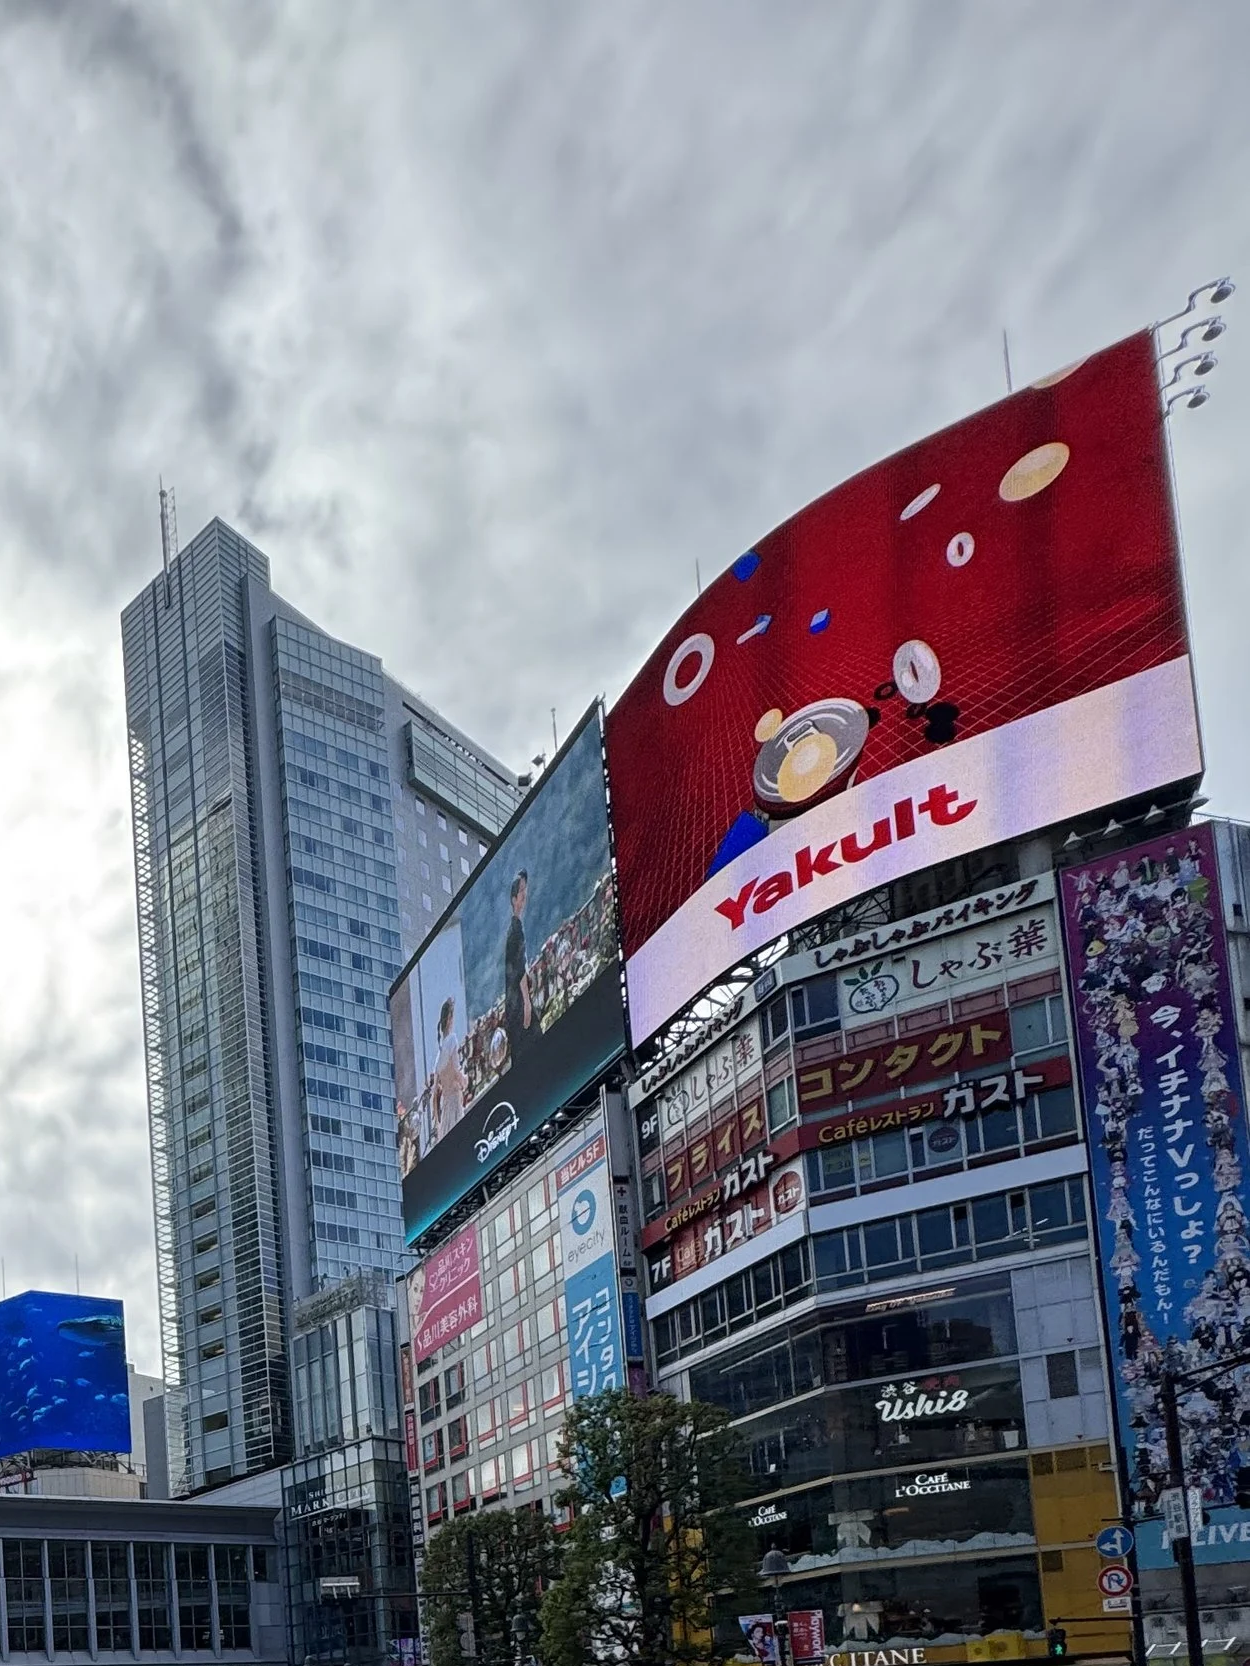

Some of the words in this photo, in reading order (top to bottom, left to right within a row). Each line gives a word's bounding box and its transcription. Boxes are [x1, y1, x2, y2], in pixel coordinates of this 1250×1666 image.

[714, 784, 978, 930] Yakult
[815, 880, 1039, 968] しゃぶしゃぶバイキング
[912, 919, 1048, 988] しゃぶ葉
[693, 1033, 755, 1101] しゃぶ葉
[800, 1023, 1003, 1101] コンタクト
[943, 1069, 1045, 1118] ガスト
[641, 1113, 658, 1140] 9F
[667, 1103, 762, 1192] プライス
[723, 1151, 775, 1203] ガスト
[777, 1186, 801, 1205] ガスト
[437, 1237, 474, 1274] 品川スキン
[567, 1227, 605, 1264] eyecity
[703, 1203, 765, 1263] ガスト
[439, 1257, 471, 1293] クリニック
[651, 1255, 672, 1284] 7F
[422, 1294, 478, 1350] 品川美容外科
[595, 1286, 617, 1392] コンタク
[572, 1297, 597, 1398] アイシ
[875, 1389, 969, 1422] Ushi8
[880, 1380, 918, 1398] 渋谷
[290, 1498, 330, 1517] MARK
[336, 1486, 371, 1503] CITY
[895, 1480, 972, 1498] L'OCCITANE
[1161, 1522, 1250, 1550] 1LIVE
